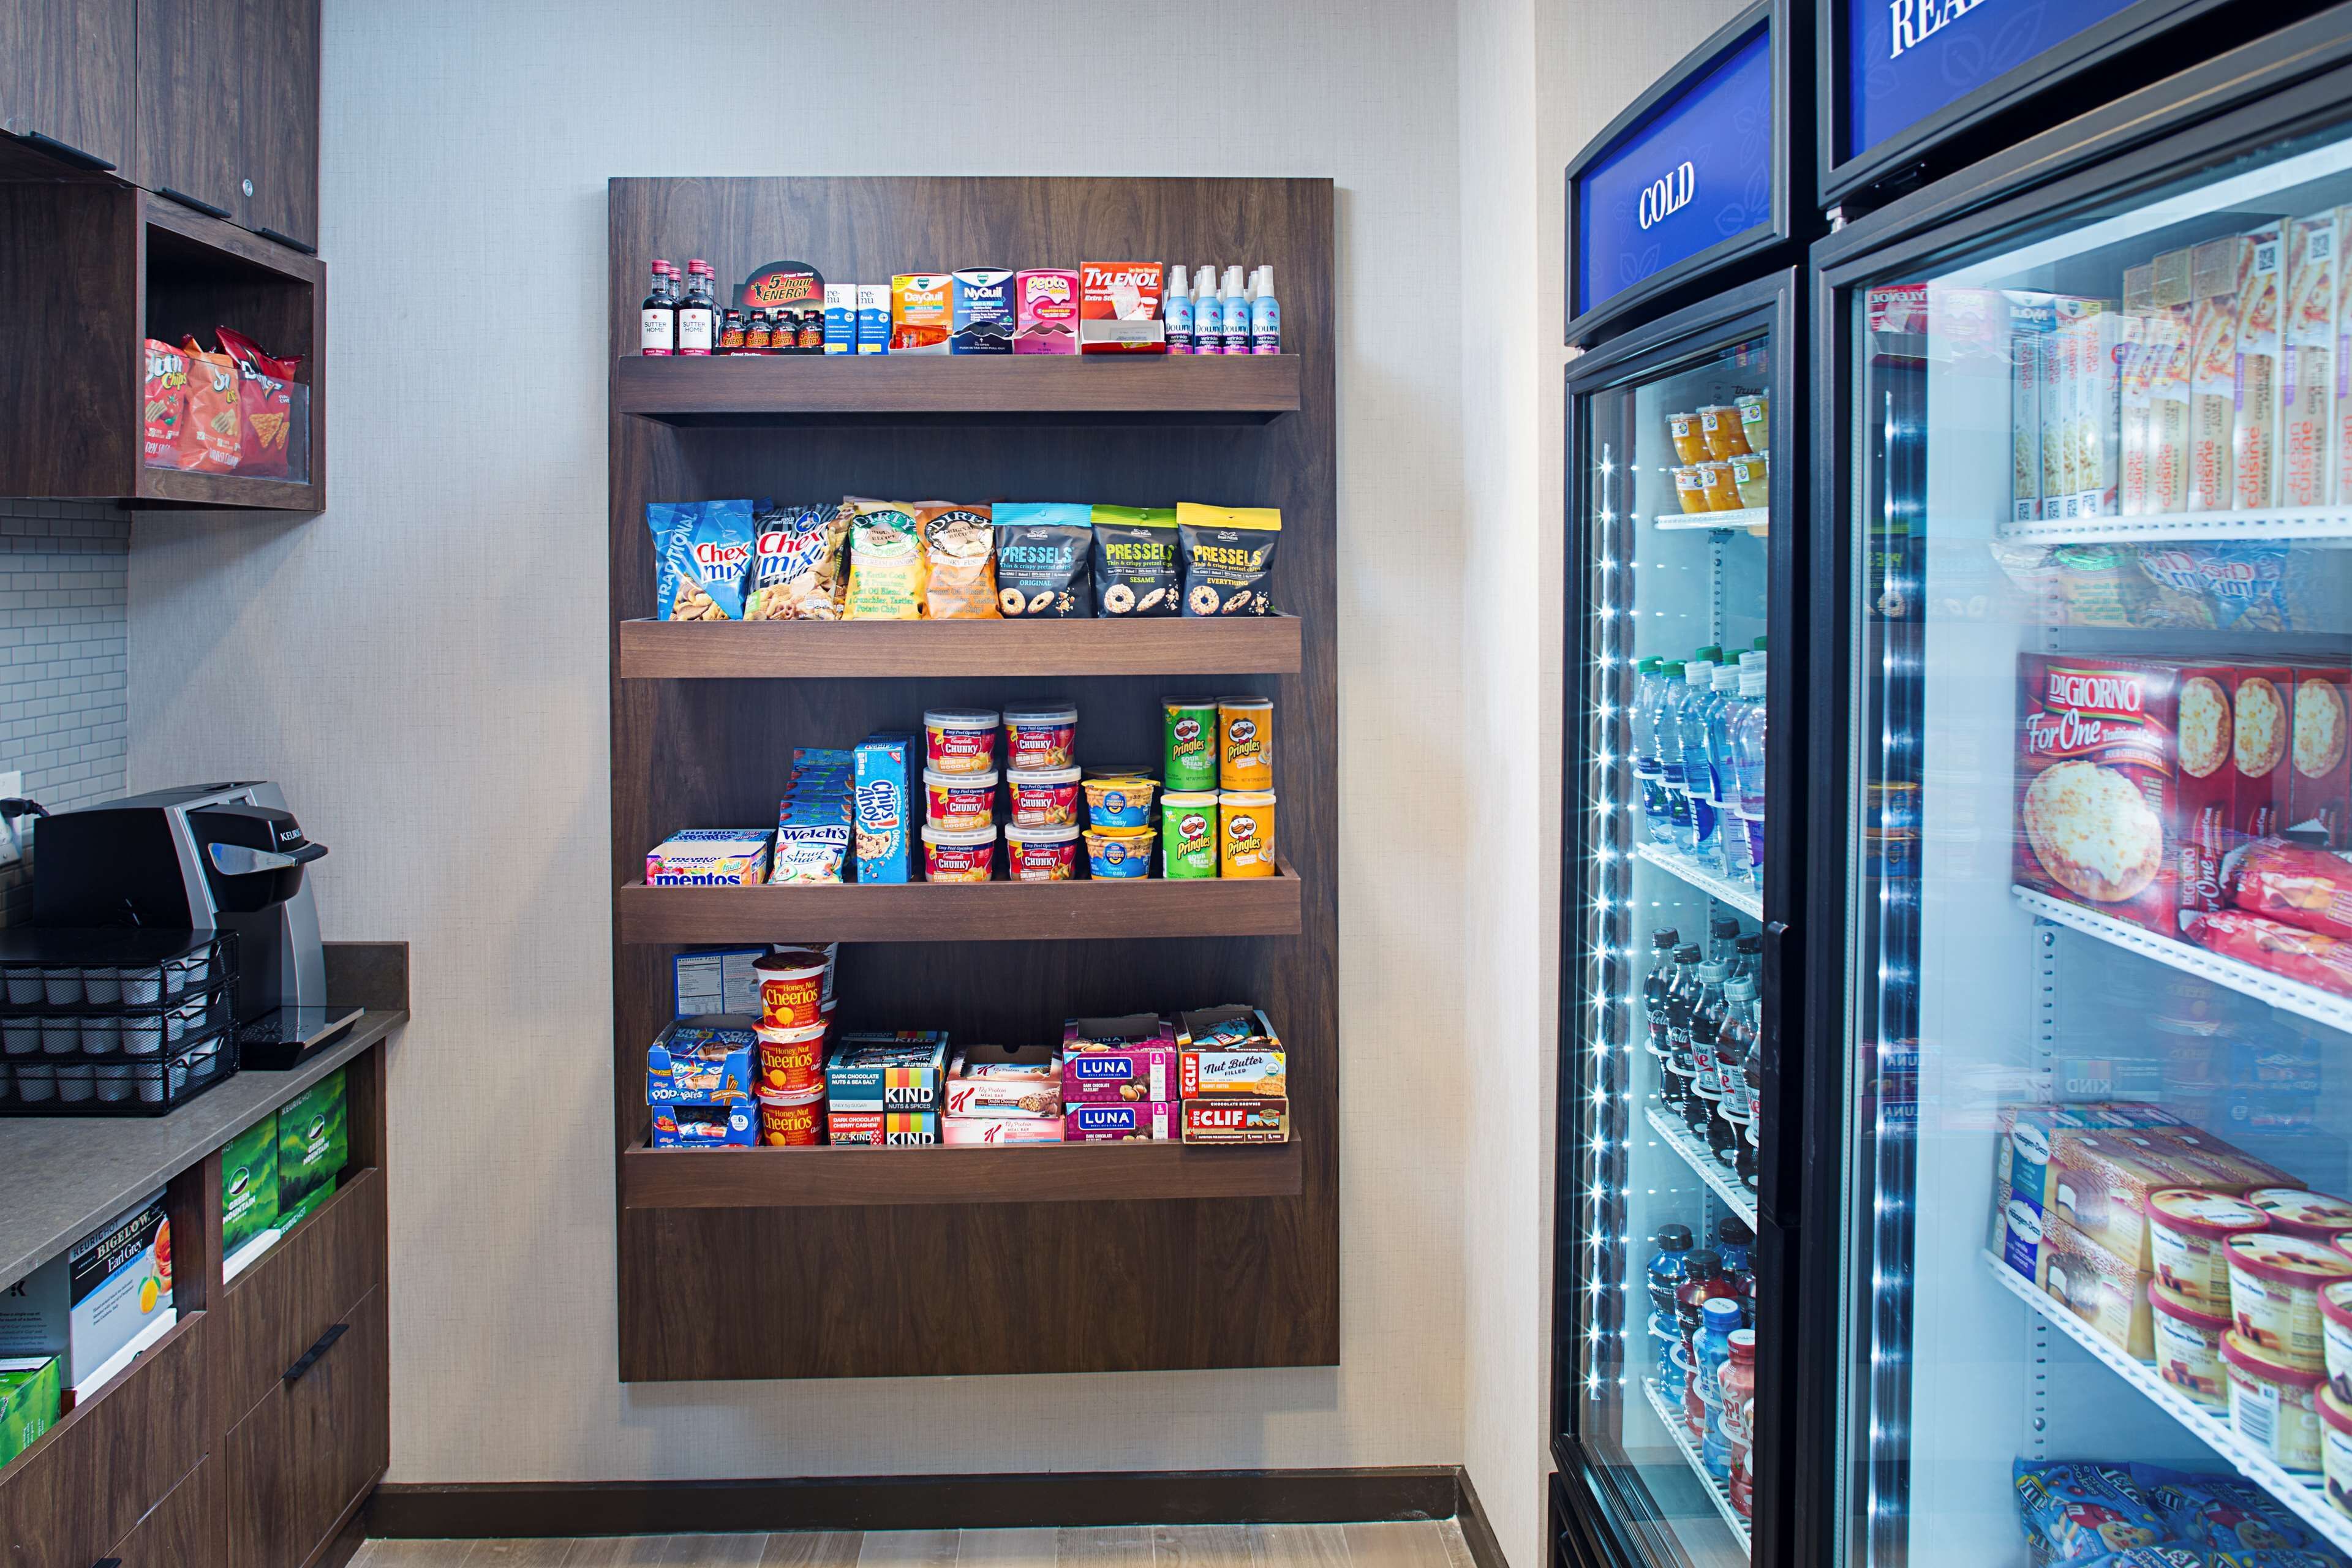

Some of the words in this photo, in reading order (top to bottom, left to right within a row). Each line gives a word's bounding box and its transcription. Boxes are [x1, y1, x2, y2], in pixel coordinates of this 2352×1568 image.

[1638, 160, 1694, 231] COLD
[1084, 269, 1158, 288] TYLENOL
[763, 287, 811, 301] ENERGY
[904, 292, 943, 303] DayQuil
[964, 287, 1002, 300] NyQuil
[162, 371, 187, 390] Chips
[759, 529, 826, 554] Chex
[657, 513, 698, 604] TRADITIONAL
[697, 543, 748, 563] Chex
[1000, 546, 1072, 564] PRESSELS
[1106, 543, 1174, 560] PRESSELS
[1193, 545, 1262, 566] PRESSELS
[705, 558, 747, 579] mix
[1207, 578, 1248, 586] EVERYTHING
[2026, 712, 2059, 754] For
[2059, 708, 2101, 750] One
[945, 745, 978, 753] CHUNKY
[1020, 740, 1051, 748] CHUNKY
[1173, 740, 1204, 761] Pringles
[1228, 739, 1260, 763] Pringles
[872, 782, 894, 820] Chips
[950, 802, 981, 812] CHUNKY
[1021, 798, 1052, 807] CHUNKY
[783, 827, 847, 841] Welch's
[884, 830, 900, 859] ORIGINAL
[1177, 836, 1210, 860] Pringles
[1227, 838, 1261, 859] Pringles
[722, 861, 741, 872] fruit
[938, 860, 970, 870] CHUNKY
[1025, 857, 1056, 866] CHUNKY
[656, 873, 741, 884] mentos
[766, 987, 818, 1006] Cheerios
[783, 983, 804, 992] Honey
[775, 1047, 796, 1055] Honey
[1695, 1043, 1708, 1054] Diet
[763, 1052, 813, 1069] Cheerios
[1083, 1061, 1127, 1072] LUNA
[1204, 1061, 1227, 1074] Nut
[1228, 1055, 1263, 1069] Butter
[1186, 1057, 1196, 1087] CLIF
[885, 1088, 933, 1102] KIND
[951, 1087, 975, 1112] K
[763, 1112, 812, 1131] Cheerios
[797, 1108, 809, 1117] Nut
[1085, 1112, 1129, 1124] LUNA
[1200, 1110, 1243, 1126] CLIF
[887, 1133, 935, 1144] KIND
[984, 1124, 1002, 1143] K
[303, 1141, 330, 1166] MOUNTAIN
[308, 1136, 325, 1153] GREEN
[228, 1190, 250, 1211] GREEN
[223, 1196, 255, 1225] MOUNTAIN
[108, 1250, 123, 1273] Earl
[124, 1238, 143, 1258] Grey
